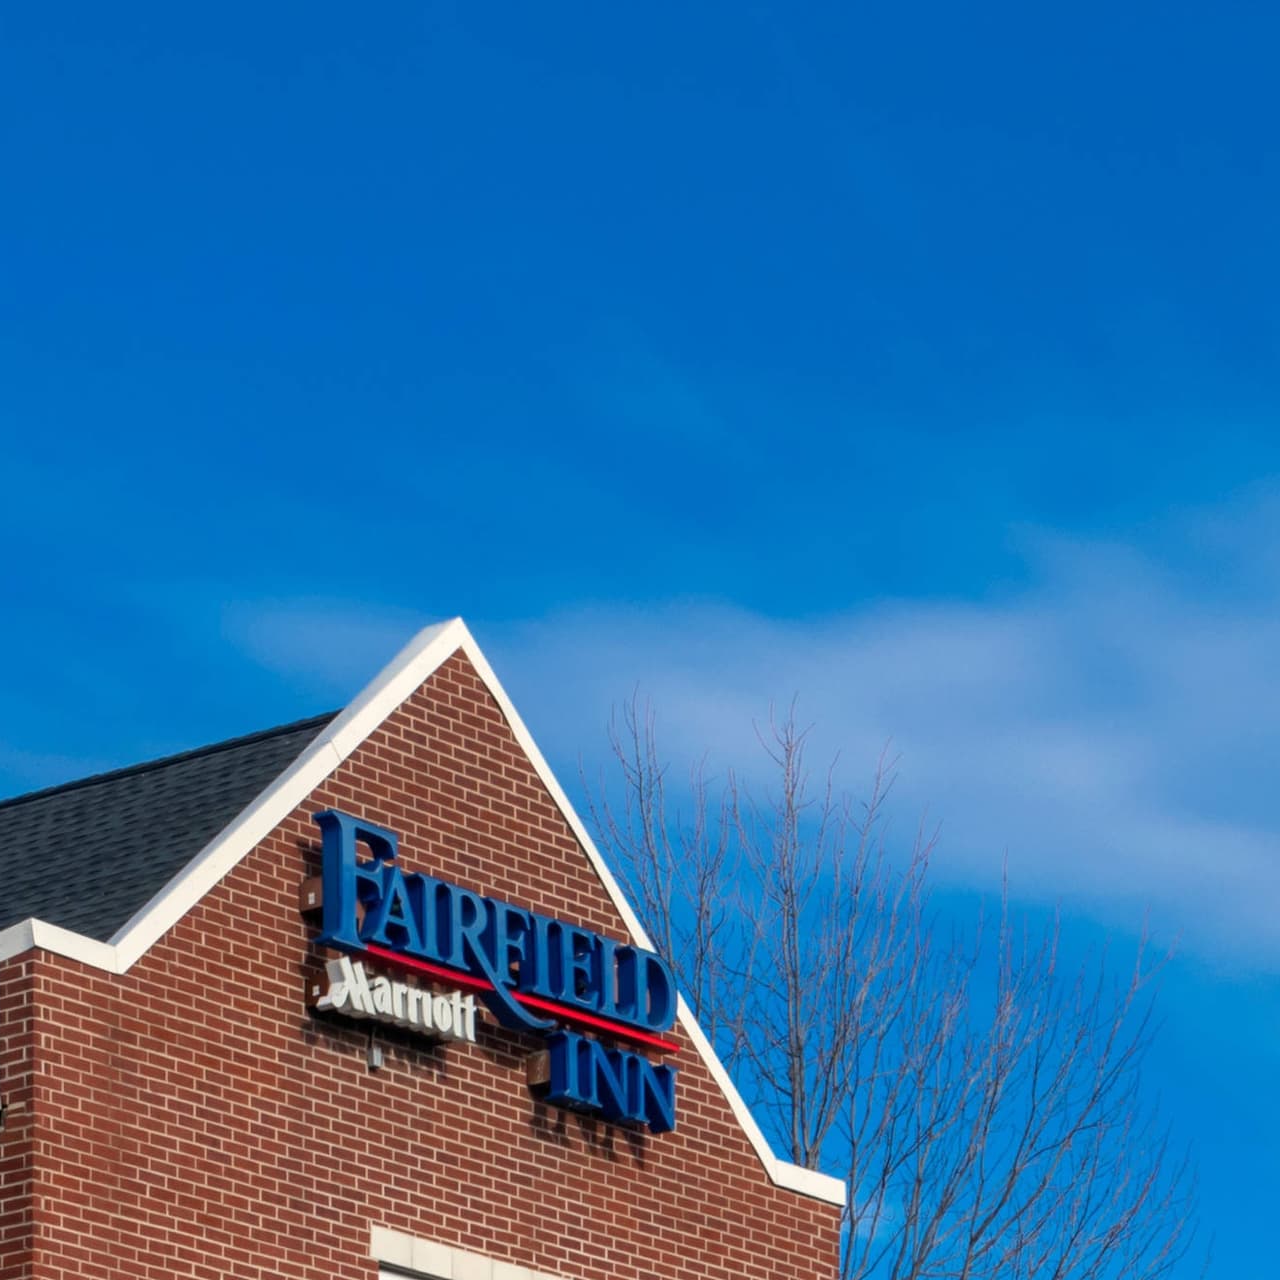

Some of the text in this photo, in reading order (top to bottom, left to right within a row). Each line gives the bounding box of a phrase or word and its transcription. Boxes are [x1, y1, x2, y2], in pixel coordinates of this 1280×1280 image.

[312, 810, 678, 1032] FAIRFIELD
[317, 957, 477, 1042] Marriott
[546, 1030, 679, 1134] INN
